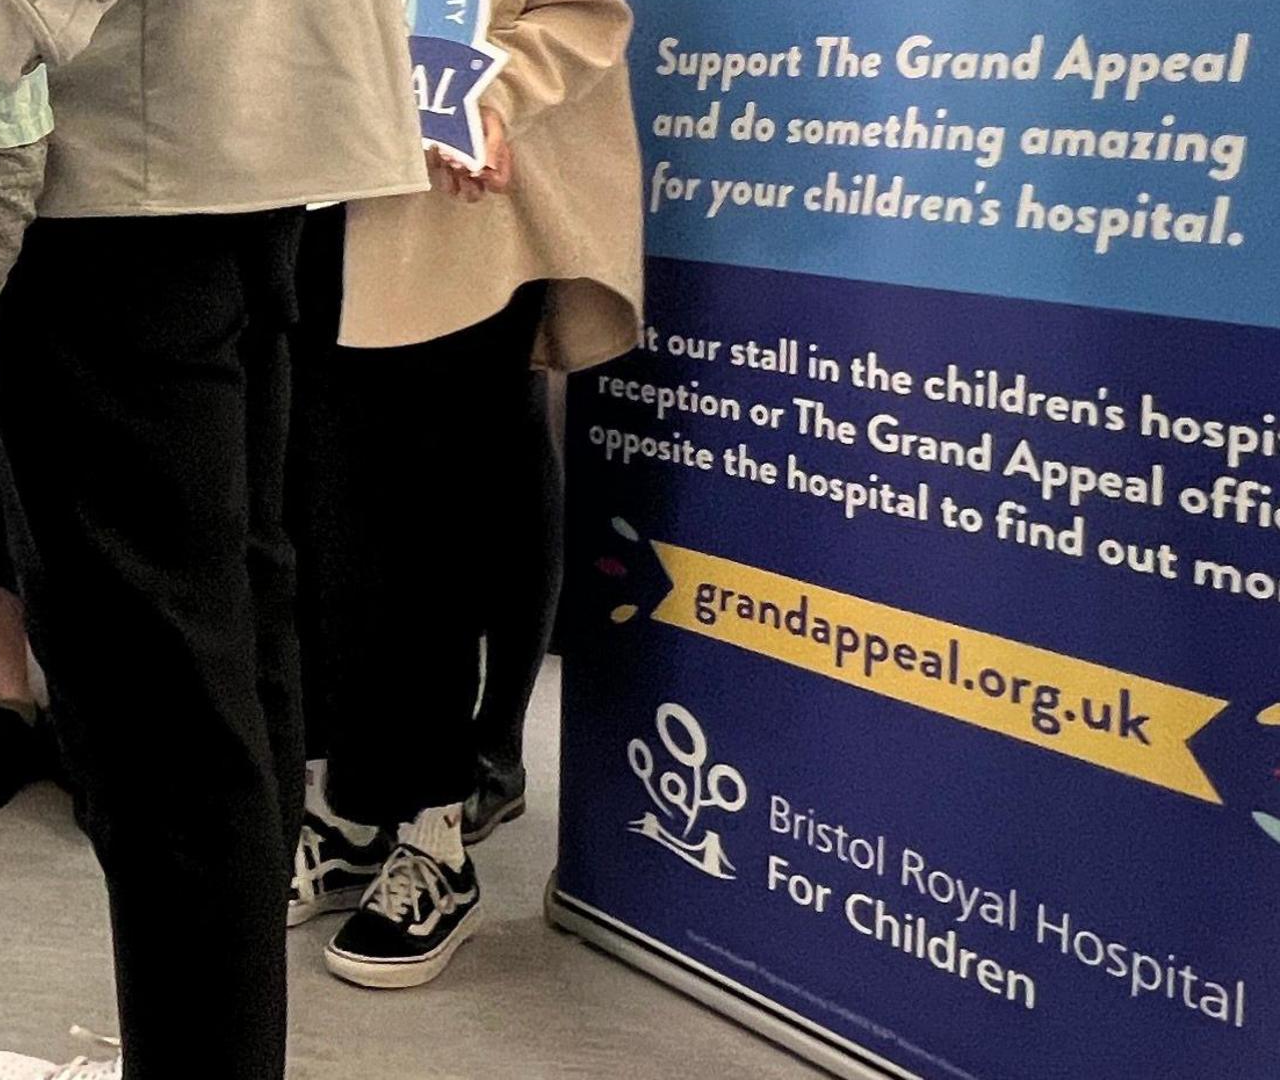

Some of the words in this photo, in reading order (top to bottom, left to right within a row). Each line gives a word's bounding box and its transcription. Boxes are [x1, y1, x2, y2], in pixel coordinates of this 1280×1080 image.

[657, 36, 802, 91] Support
[815, 35, 881, 80] The
[895, 35, 1045, 82] Grand
[1053, 32, 1252, 102] Appeal
[650, 161, 701, 213] for
[708, 177, 795, 219] your
[803, 172, 1001, 227] children's
[1015, 183, 1245, 255] hospital.
[653, 102, 718, 142] and
[730, 102, 776, 143] do
[786, 106, 1005, 168] something
[1019, 116, 1248, 180] amazing
[598, 374, 741, 420] reception
[749, 403, 784, 428] or
[792, 396, 857, 446] The
[867, 413, 992, 472] Grand
[1002, 439, 1165, 507] Appeal
[667, 333, 721, 361] our
[730, 337, 798, 375] stall
[807, 343, 839, 383] in
[850, 351, 913, 395] the
[924, 364, 1126, 431] children's
[1141, 394, 1280, 468] hospi
[589, 423, 714, 471] opposite
[723, 443, 777, 485] the
[787, 453, 929, 521] hospital
[940, 496, 983, 533] to
[995, 500, 1085, 557] find
[1097, 539, 1178, 579] out
[1193, 558, 1280, 604] mo
[694, 580, 1151, 746] grandappeal.org.uk
[767, 854, 831, 913] For
[844, 891, 1036, 1010] Children
[769, 795, 885, 877] Bristol
[900, 848, 1018, 932] Royal
[1037, 903, 1245, 1028] Hospital
